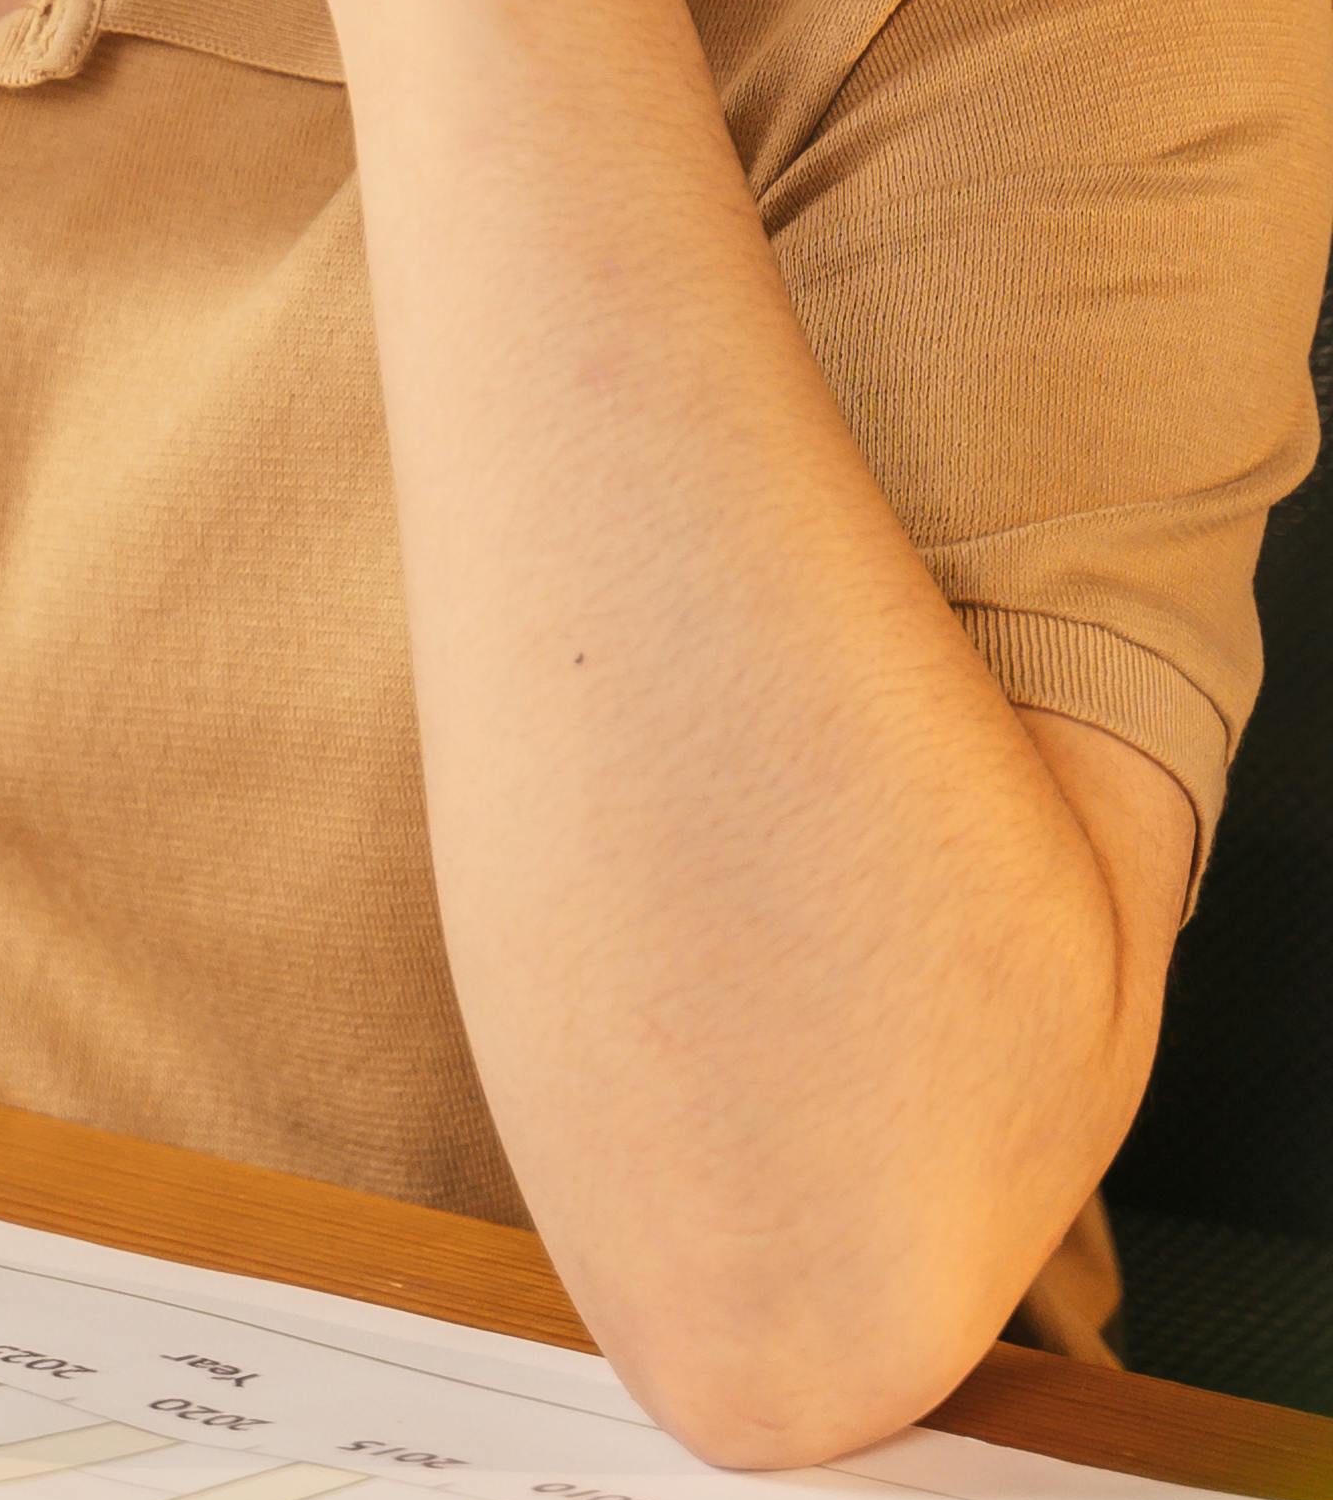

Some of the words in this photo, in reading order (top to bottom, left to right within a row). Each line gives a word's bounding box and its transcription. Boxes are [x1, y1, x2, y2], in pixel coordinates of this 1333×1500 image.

[157, 1348, 261, 1390] Year
[145, 1395, 272, 1432] 2020
[334, 1437, 469, 1470] 2015
